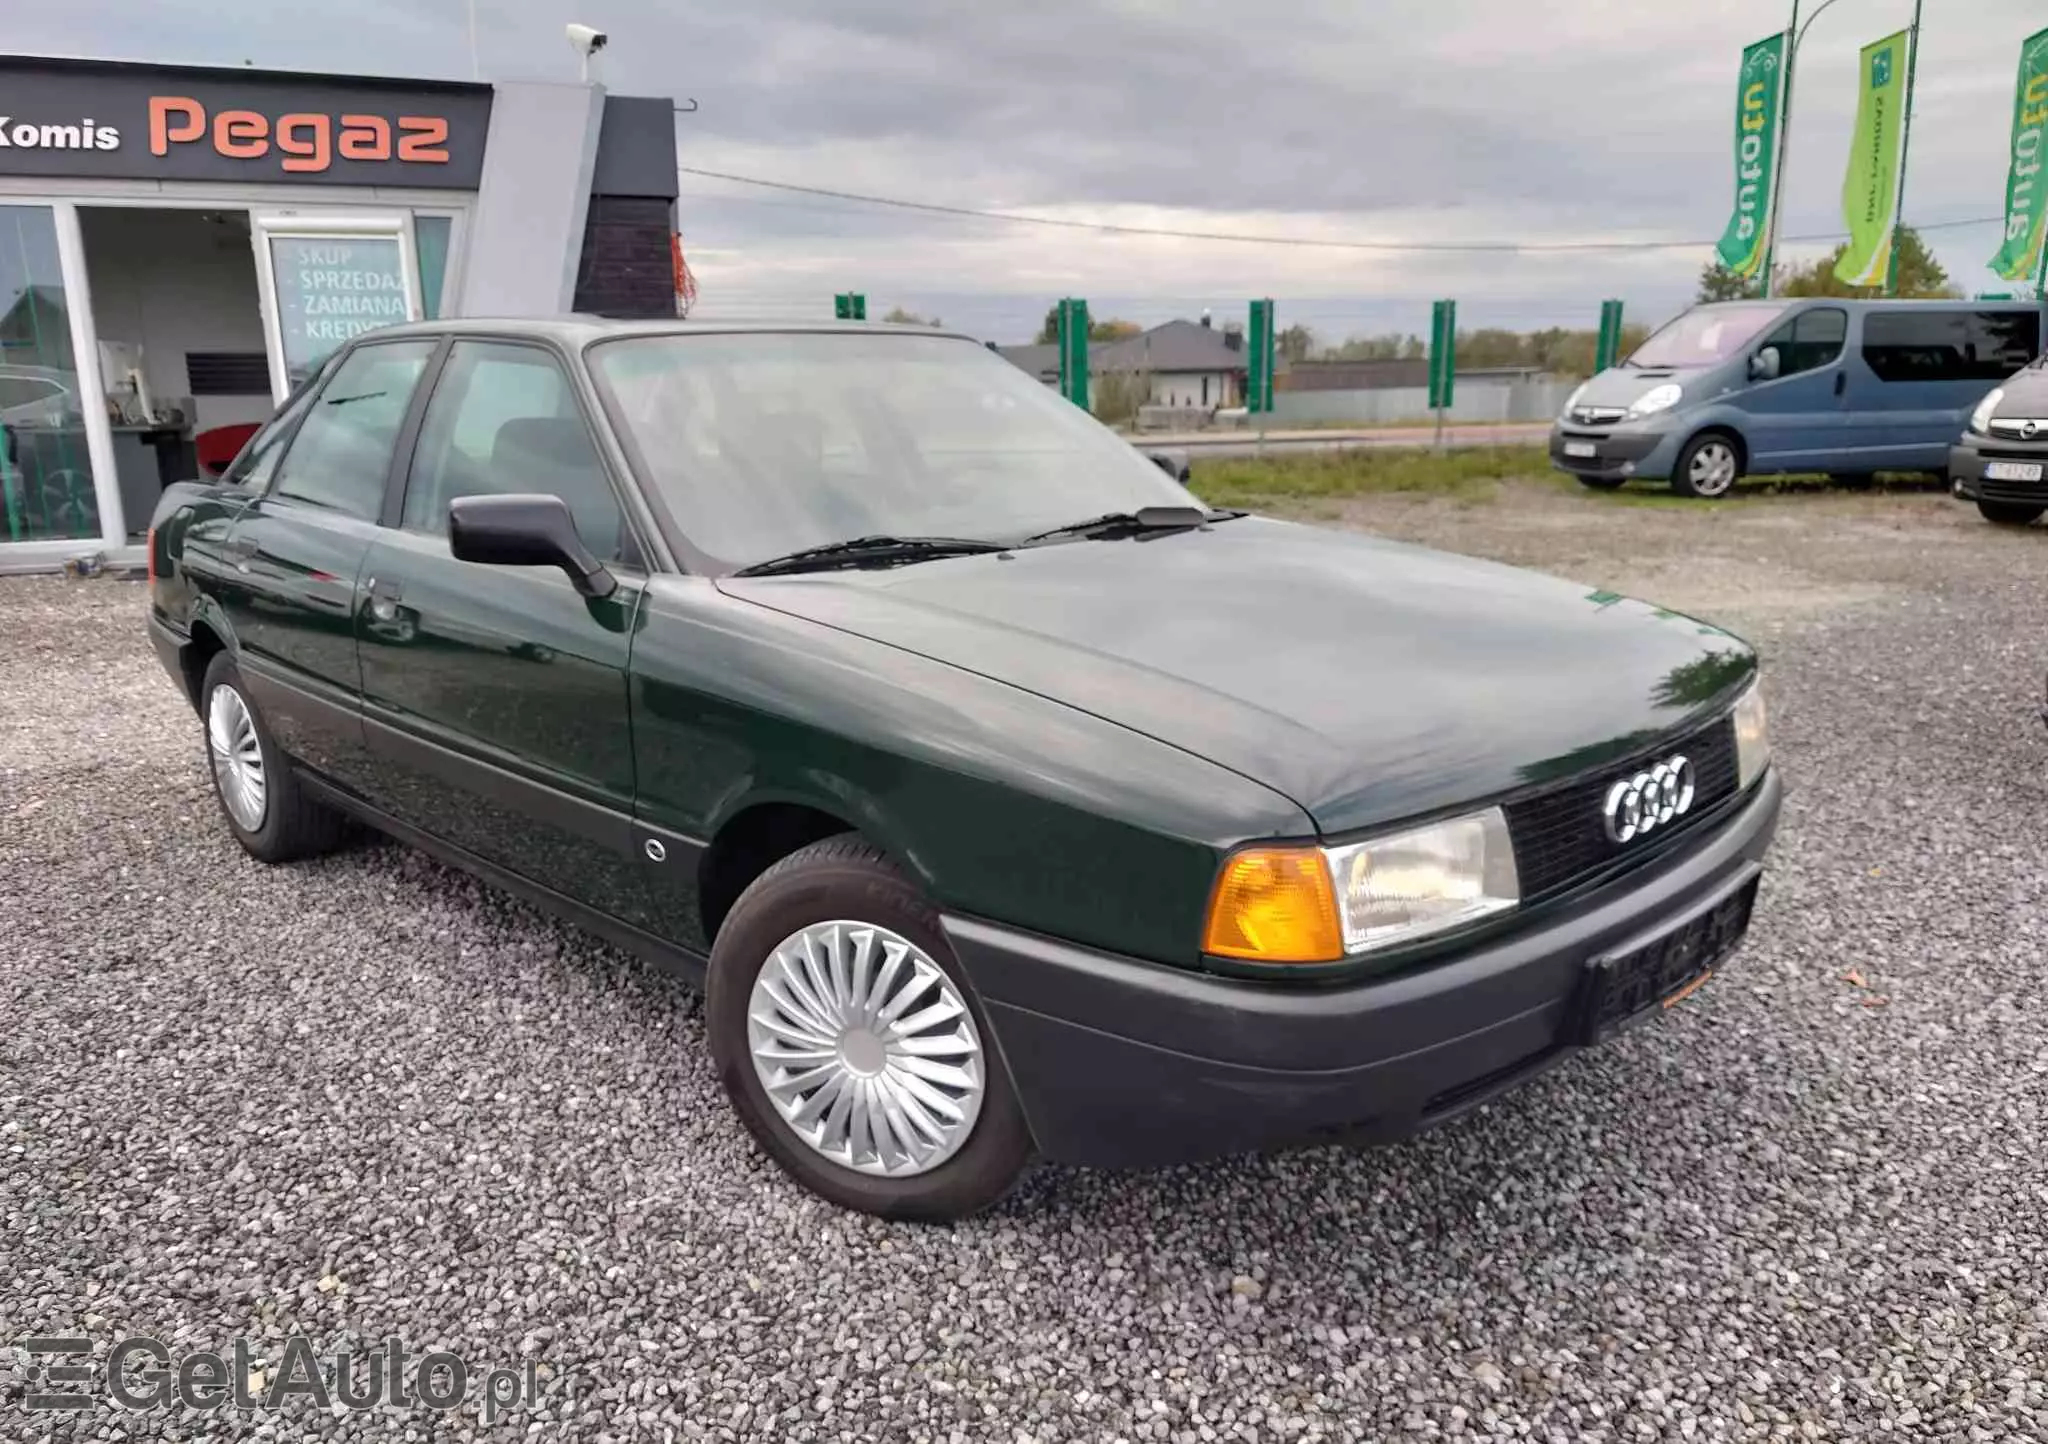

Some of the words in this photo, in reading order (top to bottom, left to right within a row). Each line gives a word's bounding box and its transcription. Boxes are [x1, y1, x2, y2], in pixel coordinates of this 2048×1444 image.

[148, 96, 449, 172] Pegaz
[300, 246, 352, 265] SKUP
[304, 295, 406, 315] ZAMIANA
[305, 320, 391, 339] KREDY
